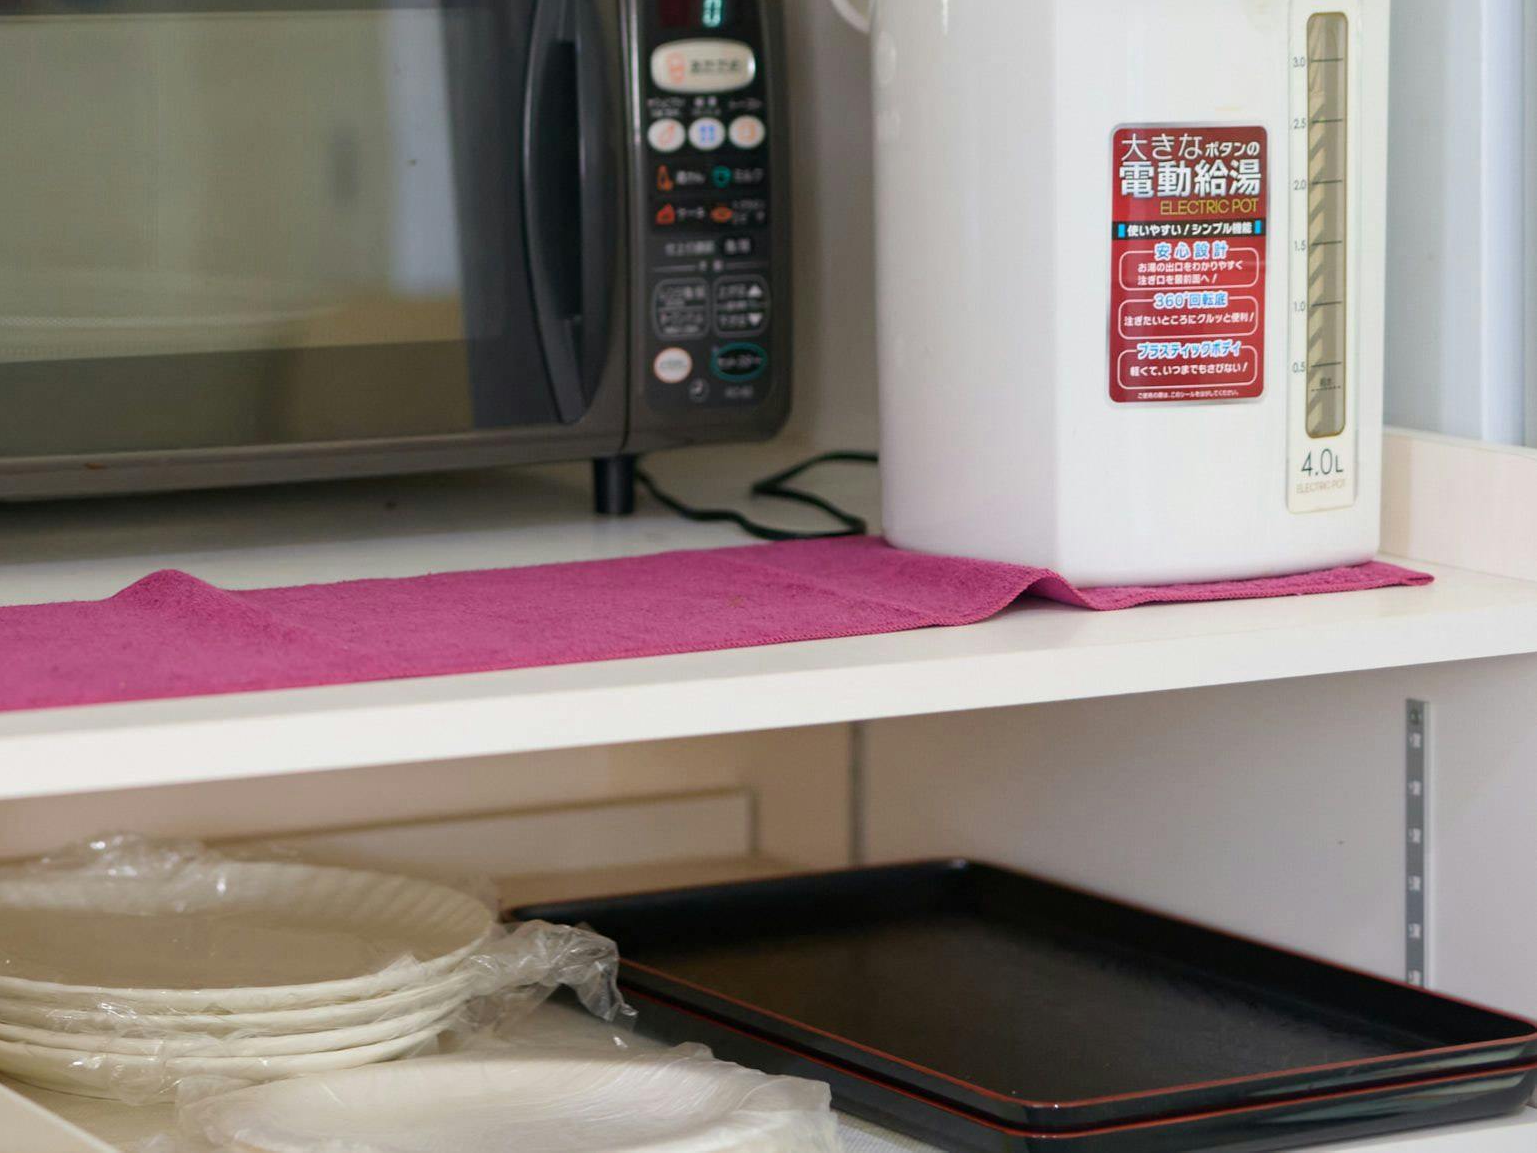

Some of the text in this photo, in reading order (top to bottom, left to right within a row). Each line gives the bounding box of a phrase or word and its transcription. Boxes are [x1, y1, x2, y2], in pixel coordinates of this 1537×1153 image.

[1293, 57, 1306, 68] 3.0
[1293, 118, 1307, 130] 2.5
[1120, 133, 1260, 161] 大きなボタンの
[1119, 158, 1262, 198] 電動給湯
[1293, 179, 1307, 191] 2.0
[1160, 197, 1259, 216] ELECTRIC POT
[1153, 240, 1229, 261] 安心設計
[1293, 240, 1307, 252] 1.5
[1137, 260, 1243, 273] お湯の出口をわかりやすく
[1293, 301, 1306, 312] 1.0
[1136, 339, 1243, 360] プラスティックボディ
[1292, 362, 1306, 374] 0.5
[1301, 448, 1345, 477] 4.0L
